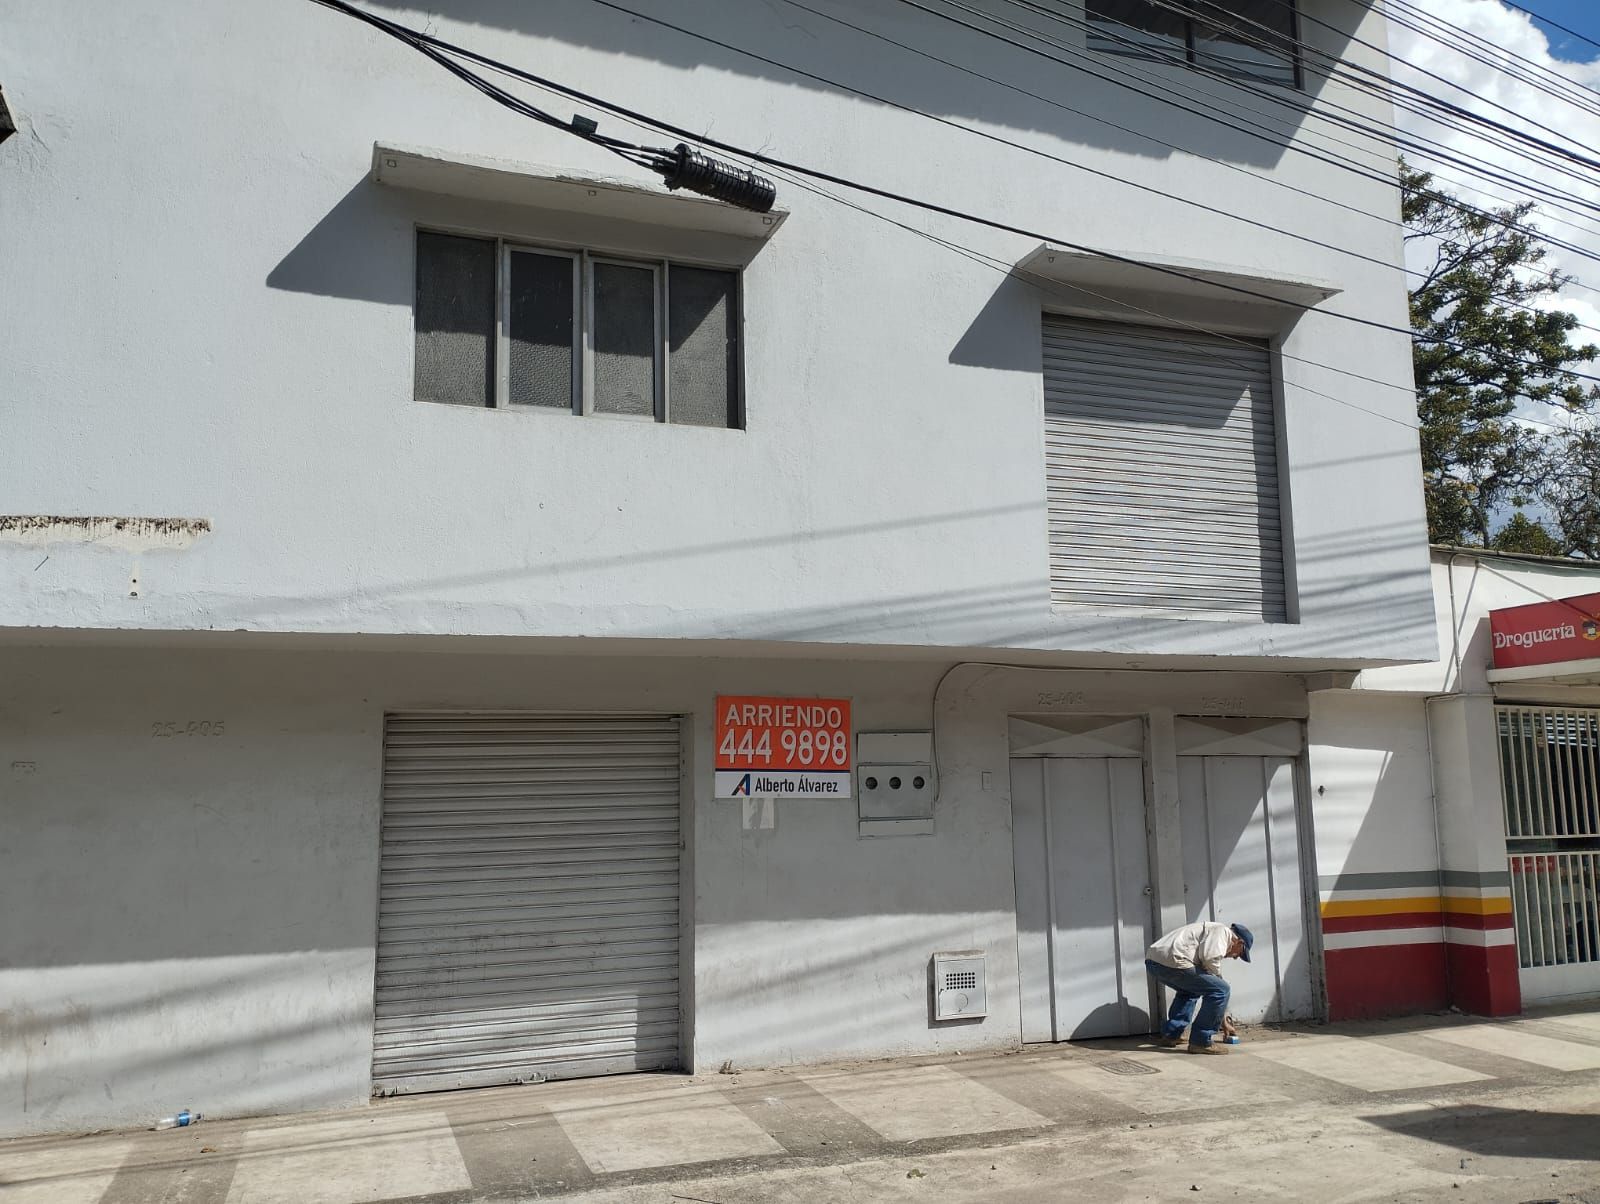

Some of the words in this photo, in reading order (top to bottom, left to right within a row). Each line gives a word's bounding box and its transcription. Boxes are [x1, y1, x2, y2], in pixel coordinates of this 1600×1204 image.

[1493, 622, 1576, 648] Droguería
[725, 704, 842, 728] ARRIENDO
[719, 729, 772, 764] 444
[781, 729, 847, 765] 9898
[755, 778, 795, 793] Alberto
[798, 774, 838, 793] Álvarez
